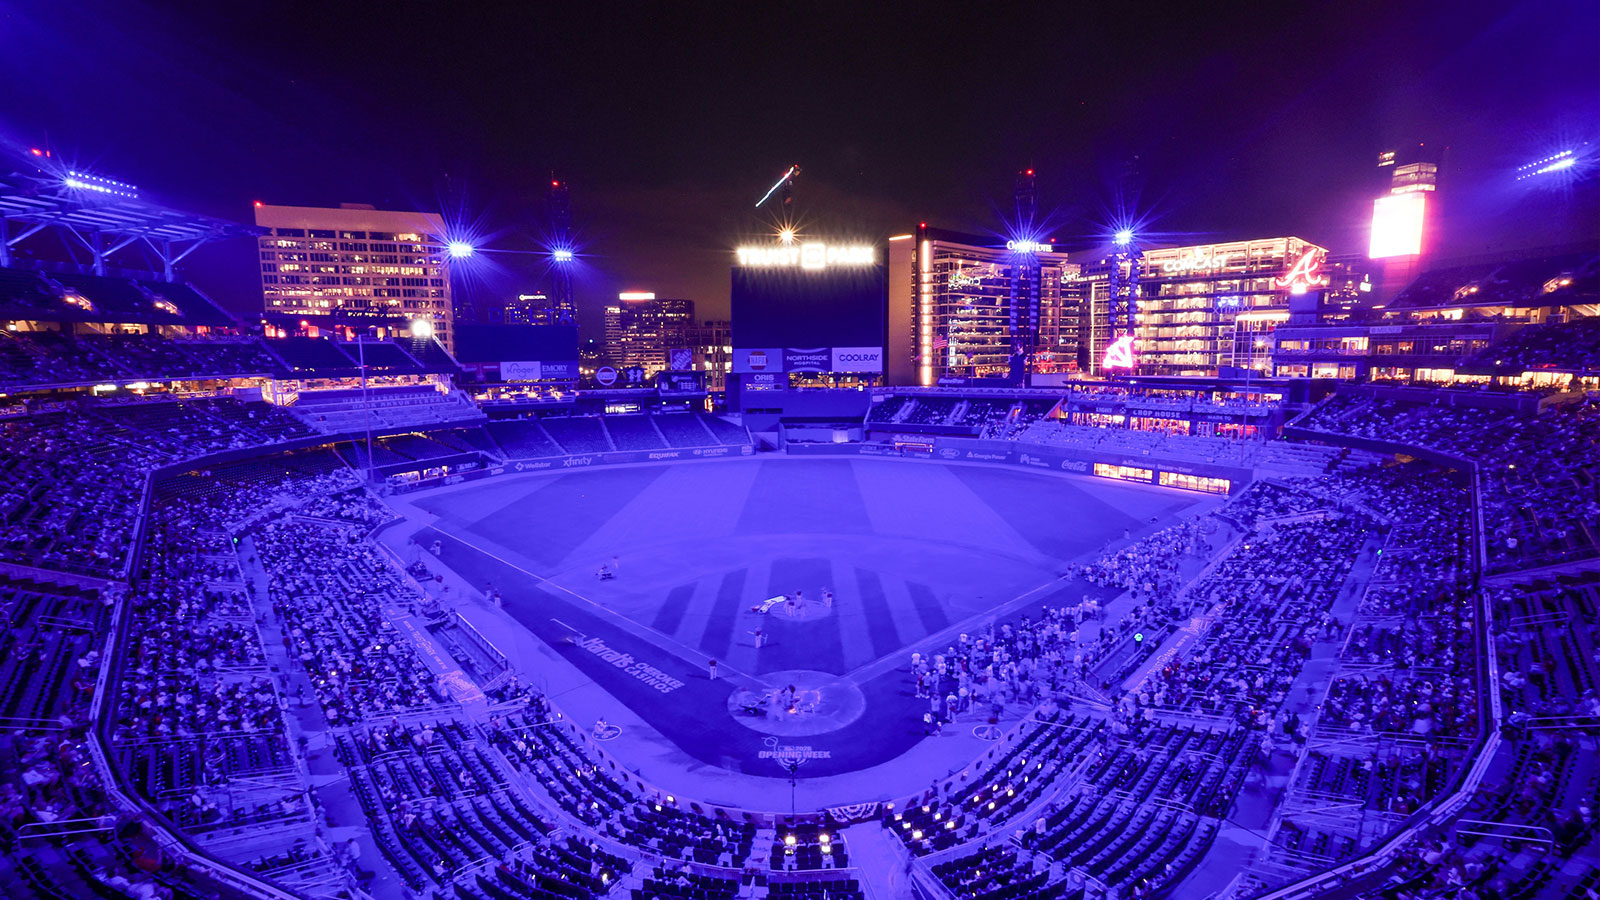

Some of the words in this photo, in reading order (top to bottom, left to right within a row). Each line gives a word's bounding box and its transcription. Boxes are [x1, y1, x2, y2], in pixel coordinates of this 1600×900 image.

[1163, 255, 1227, 272] COMCAST
[489, 307, 574, 323] DELTA
[839, 354, 879, 362] COOLRAY
[506, 363, 534, 378] Kroger
[562, 456, 592, 467] xfinity
[648, 451, 680, 460] EQUIFAX
[624, 666, 674, 693] CASINOS
[635, 662, 685, 689] CHEROKEE
[758, 750, 802, 759] OPENING
[802, 750, 832, 759] WEEK
